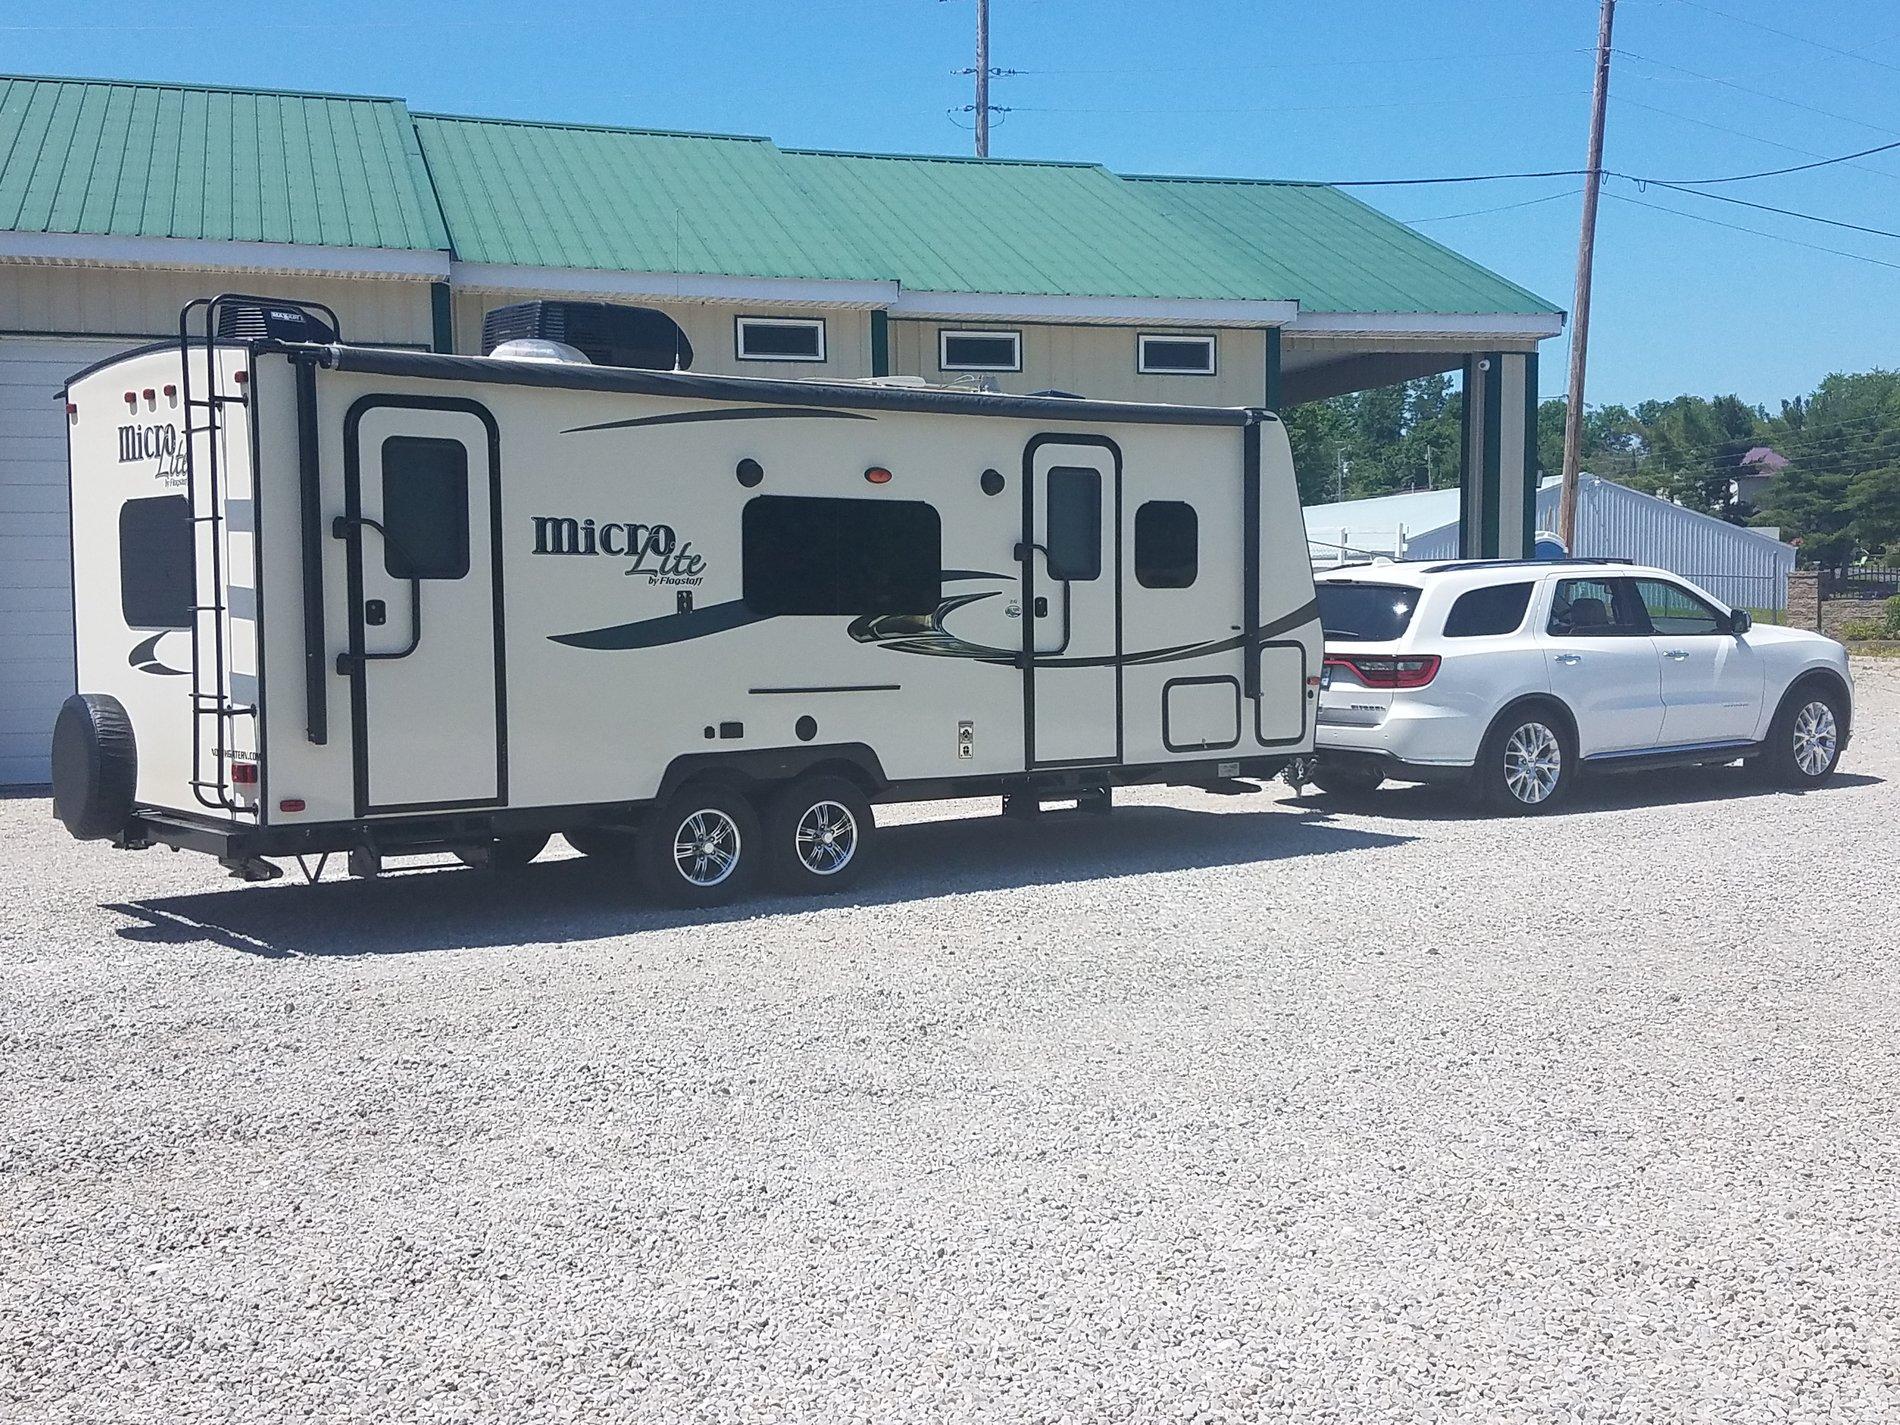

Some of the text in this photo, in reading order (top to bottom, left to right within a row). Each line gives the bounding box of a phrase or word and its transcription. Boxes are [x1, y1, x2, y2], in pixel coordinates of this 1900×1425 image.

[118, 423, 176, 463] micro
[531, 516, 676, 556] micro
[625, 541, 707, 577] Lite
[648, 576, 704, 587] by Flagstaff
